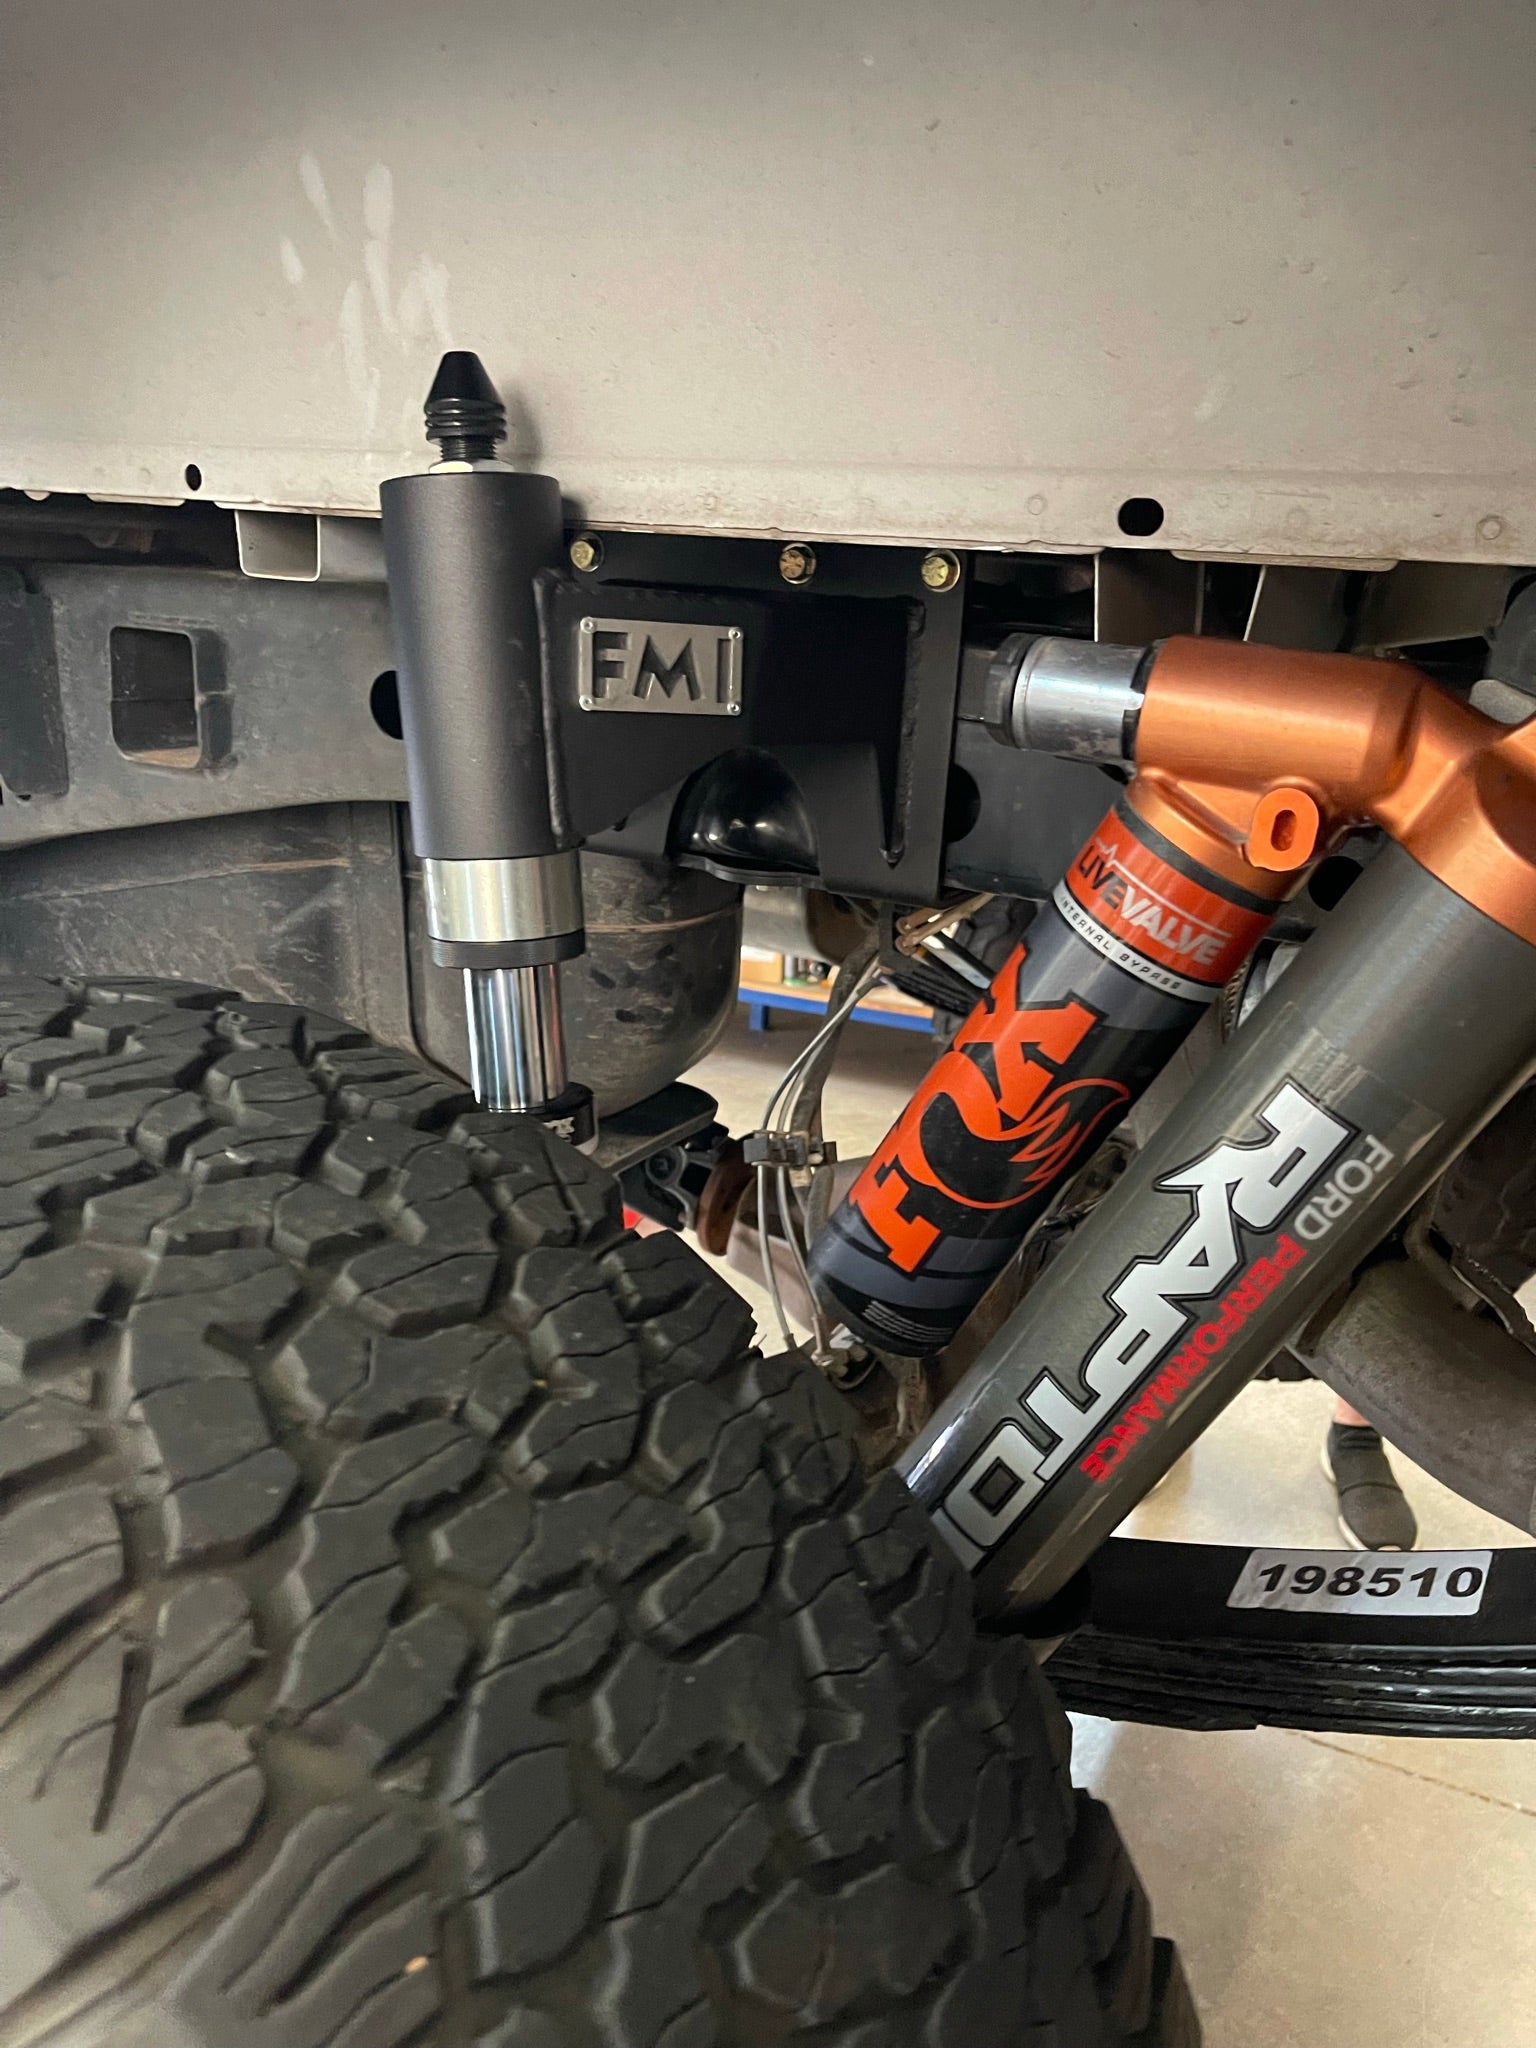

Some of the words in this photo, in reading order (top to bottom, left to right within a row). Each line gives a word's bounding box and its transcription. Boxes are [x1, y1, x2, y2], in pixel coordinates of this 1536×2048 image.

[592, 631, 732, 704] FMI
[1060, 896, 1112, 951] INTERNAL
[1118, 952, 1183, 990] BYPASS
[848, 942, 1131, 1273] FOX
[1293, 1134, 1395, 1241] FORD
[931, 1080, 1359, 1572] RAPTO
[1078, 1233, 1306, 1483] PERFORMANCE
[1258, 1563, 1483, 1598] 198510
